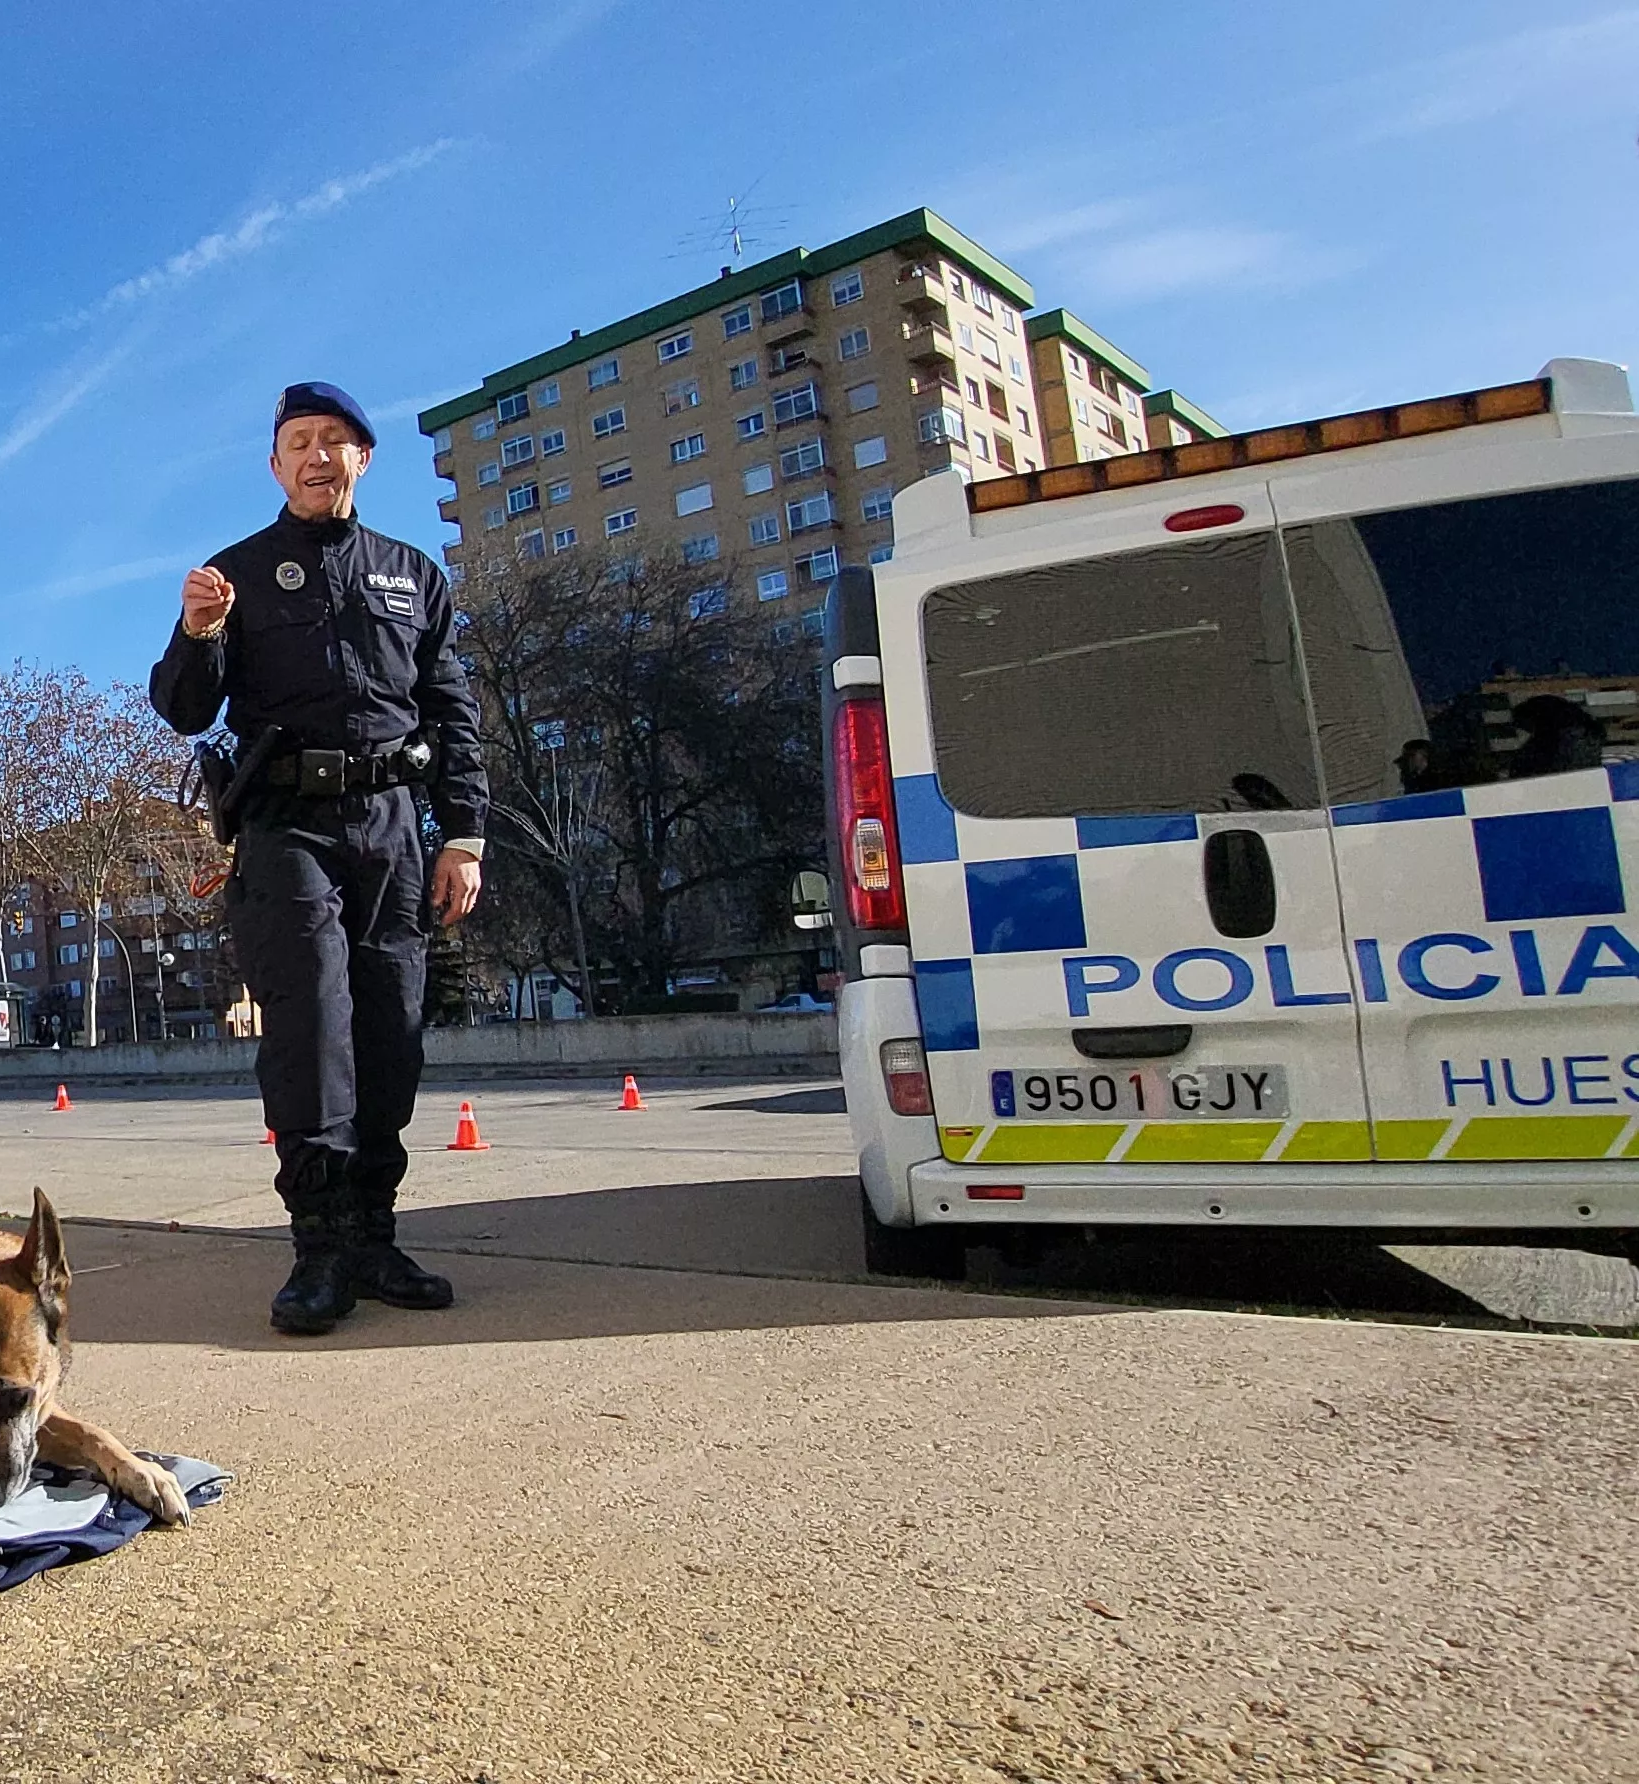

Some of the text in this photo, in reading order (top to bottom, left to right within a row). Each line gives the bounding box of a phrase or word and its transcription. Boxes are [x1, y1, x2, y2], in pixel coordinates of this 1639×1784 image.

[368, 574, 417, 592] POLICIA
[1062, 925, 1639, 1018] POLICIA
[1024, 1072, 1268, 1112] 9501 GJY
